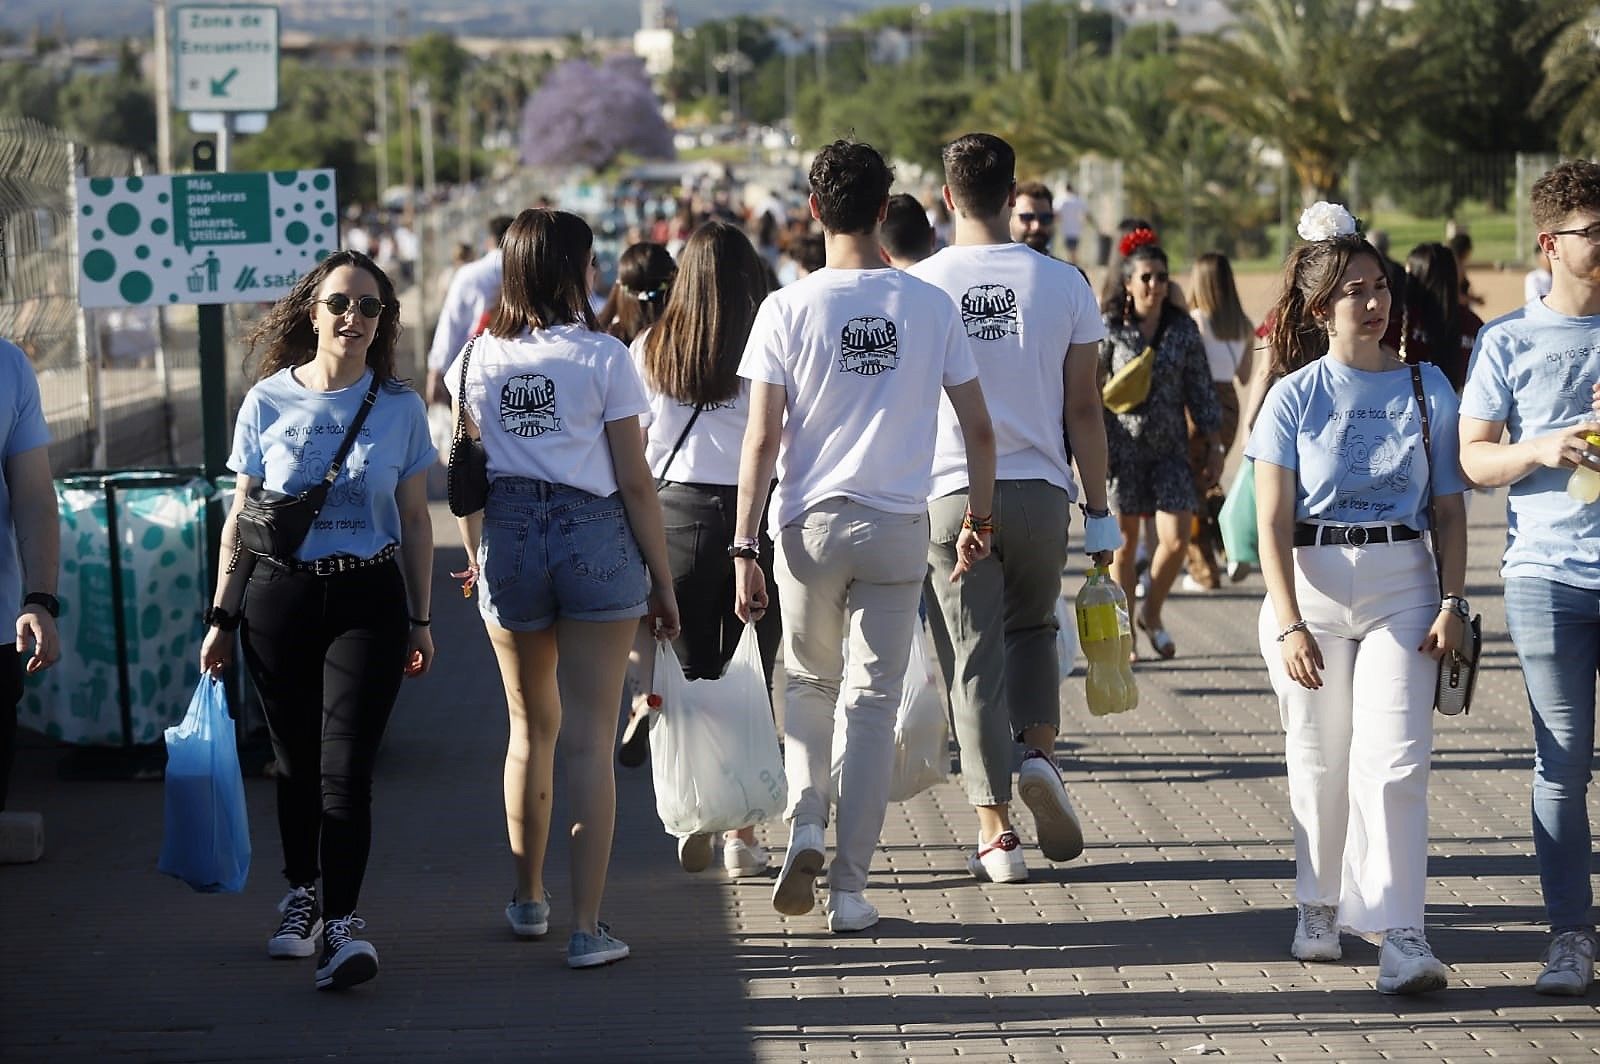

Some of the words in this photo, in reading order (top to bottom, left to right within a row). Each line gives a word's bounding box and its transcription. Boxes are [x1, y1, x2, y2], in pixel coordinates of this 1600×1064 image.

[190, 14, 233, 29] Zona
[239, 14, 262, 29] de
[181, 41, 271, 56] Encuentro
[187, 178, 213, 191] Más
[187, 191, 247, 206] papeleras
[188, 206, 211, 219] que
[189, 218, 238, 229] lunares.
[1356, 408, 1366, 419] se
[1368, 406, 1387, 419] toca
[285, 425, 299, 441] Hoy
[302, 424, 313, 435] no
[314, 424, 324, 435] se
[326, 421, 345, 434] toca
